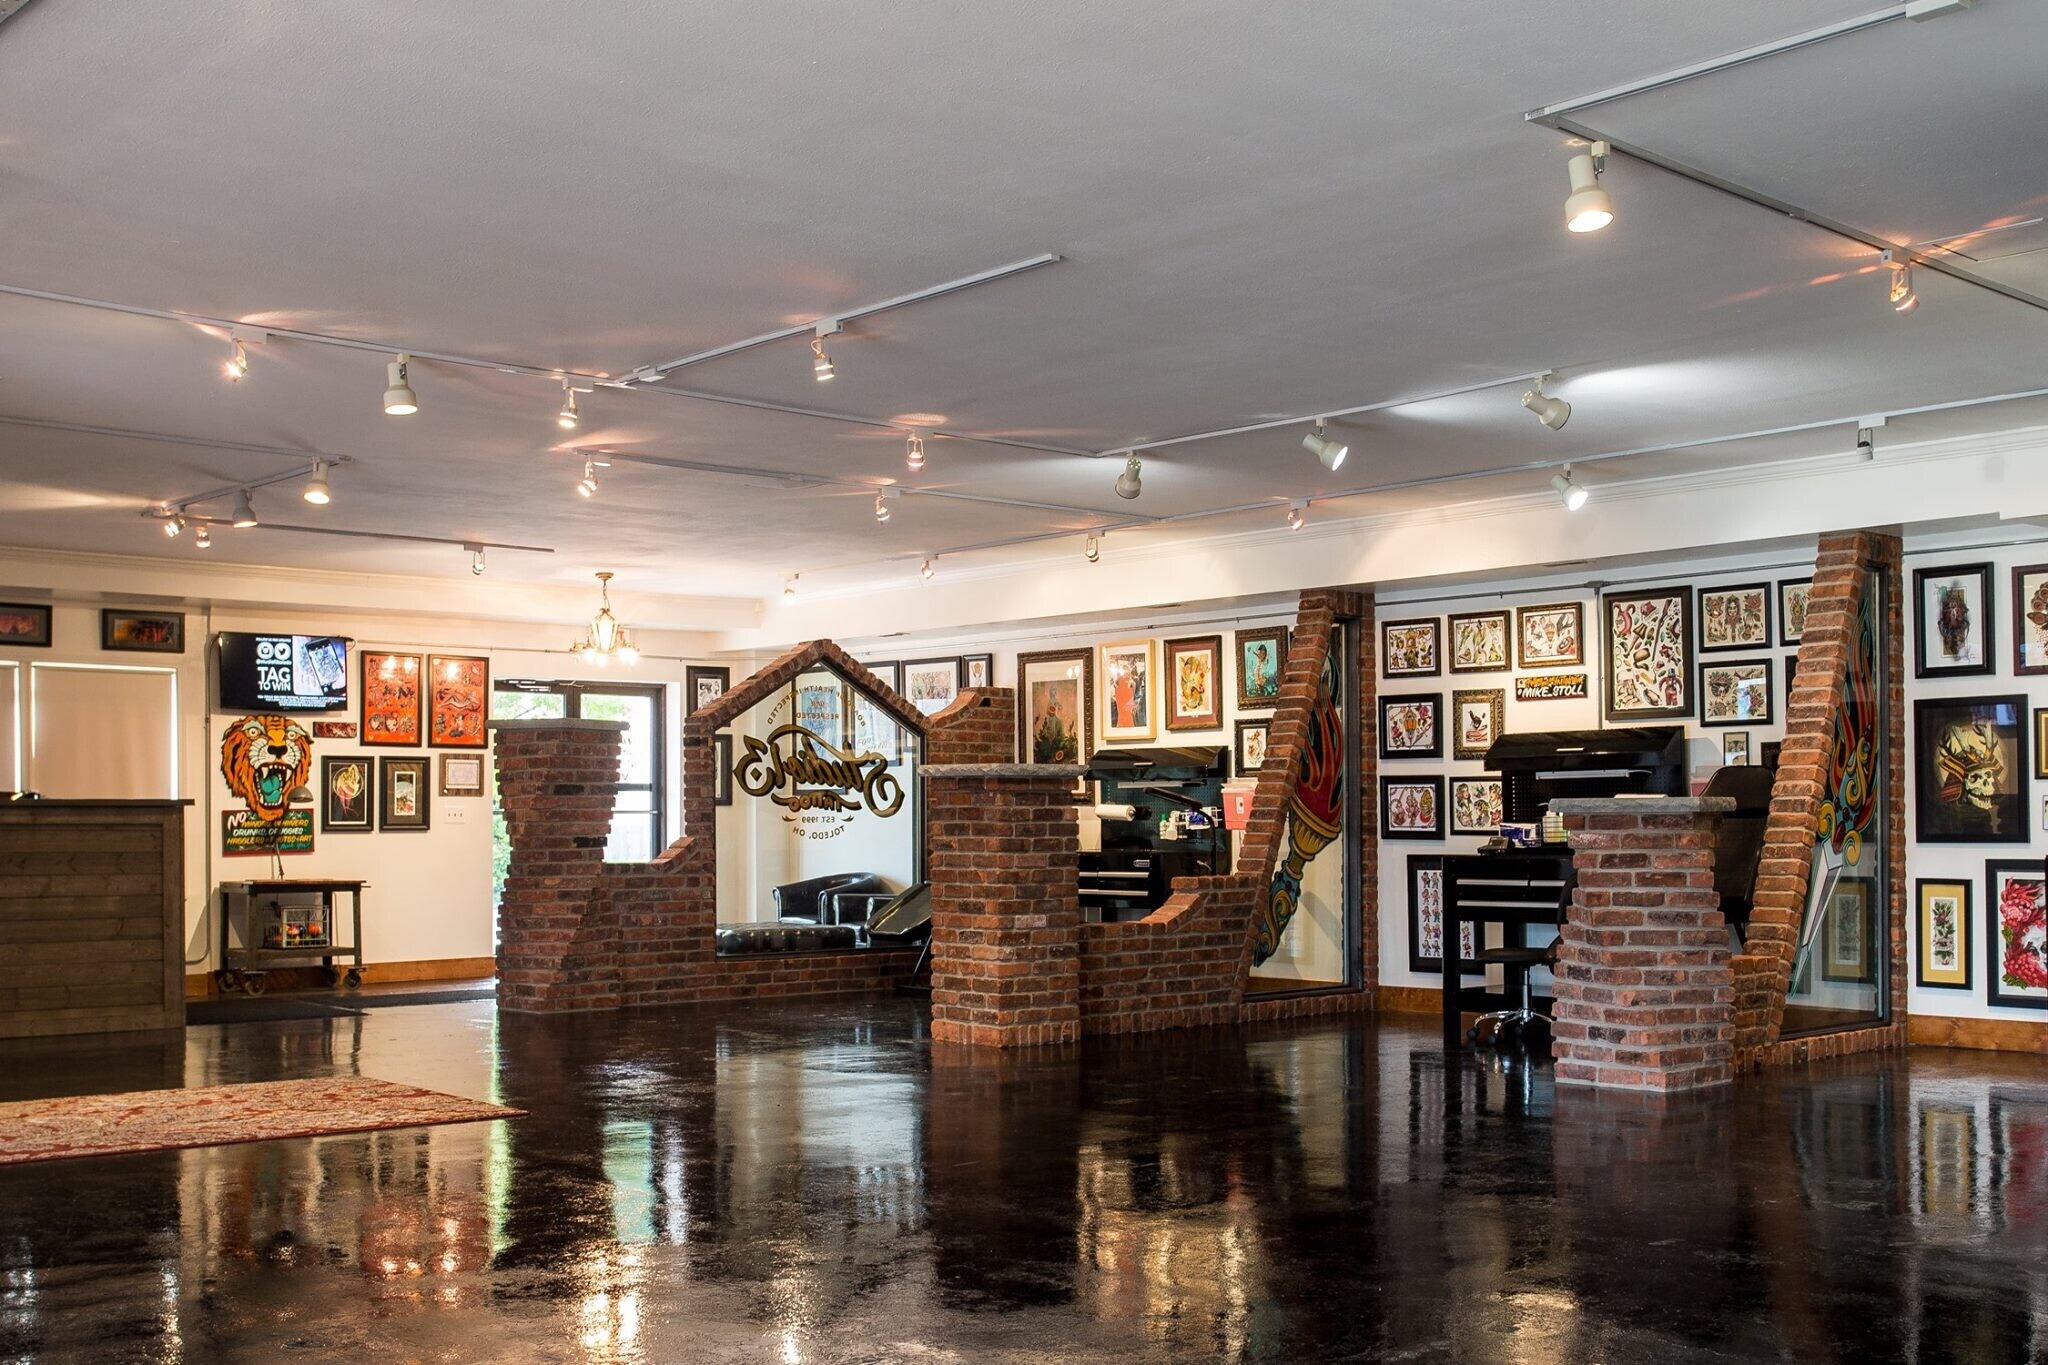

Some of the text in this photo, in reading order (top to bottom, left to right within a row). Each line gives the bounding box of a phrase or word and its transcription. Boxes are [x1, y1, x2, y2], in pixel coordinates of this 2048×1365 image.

[257, 667, 291, 682] TAG
[258, 681, 291, 691] TO WIN
[1522, 685, 1584, 698] MIKE STOLL
[228, 812, 246, 830] NO
